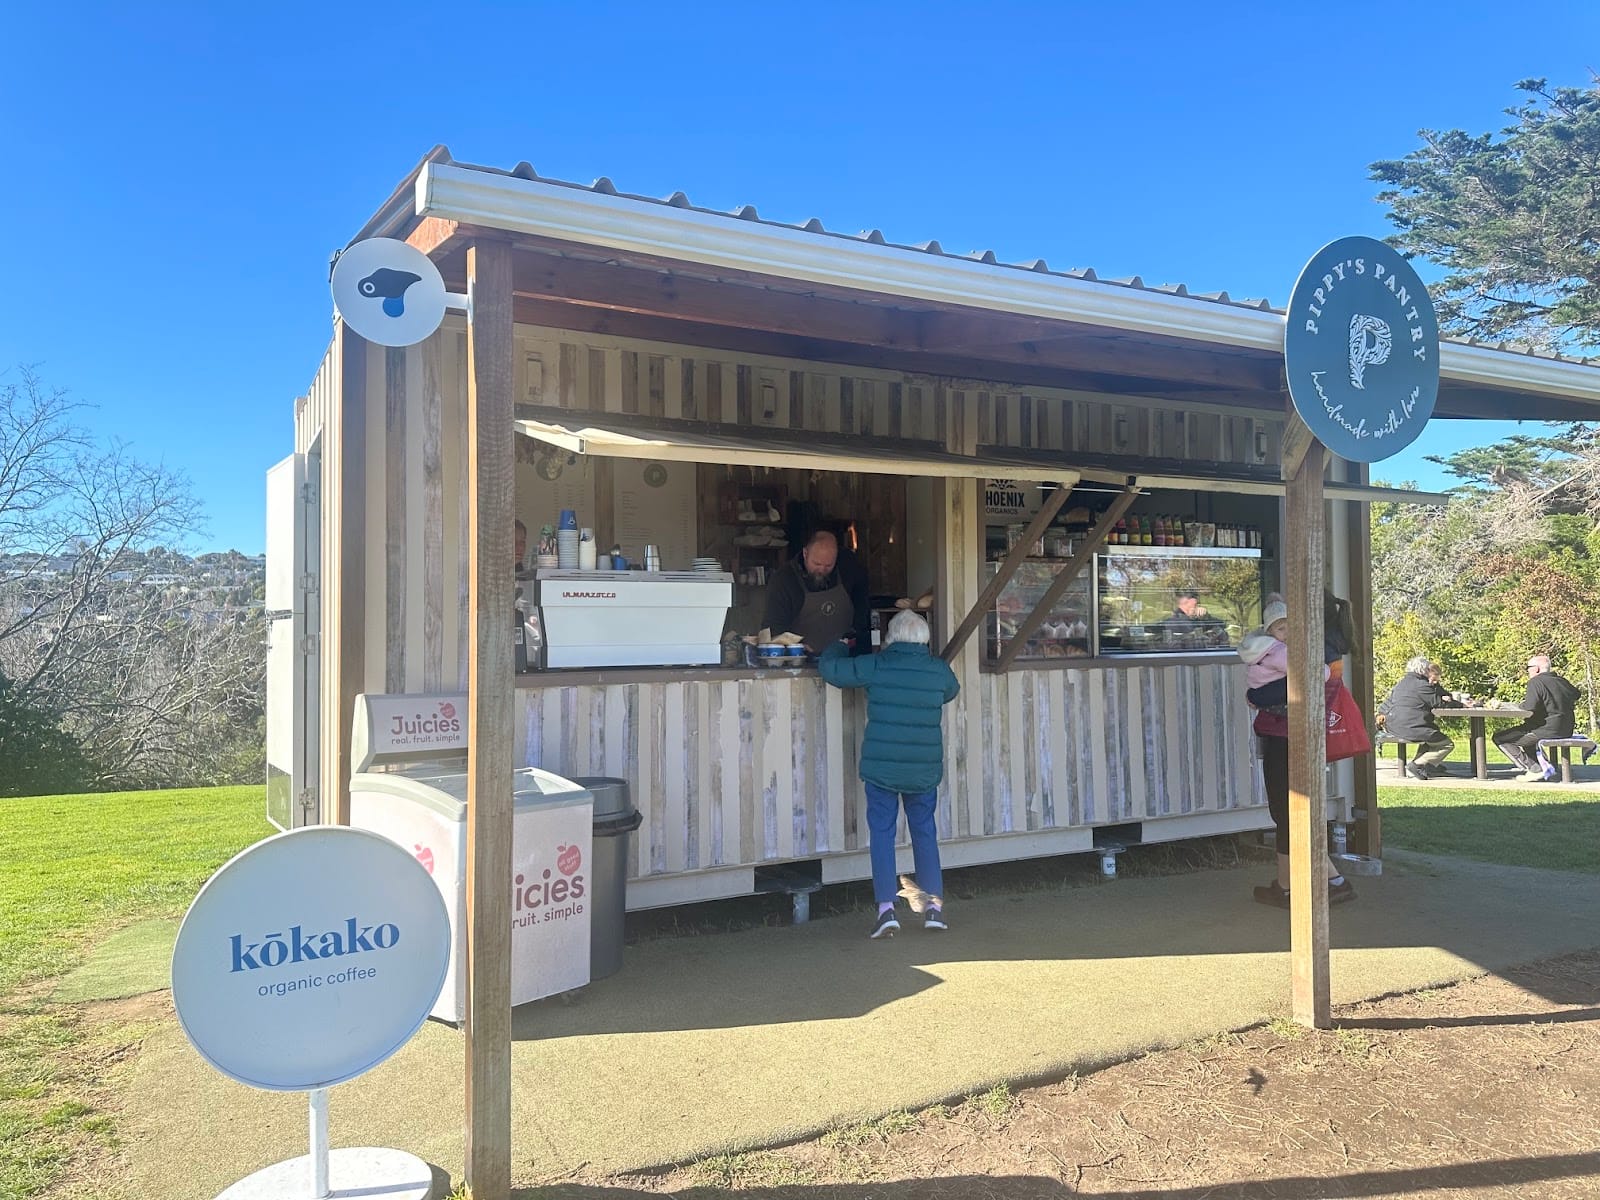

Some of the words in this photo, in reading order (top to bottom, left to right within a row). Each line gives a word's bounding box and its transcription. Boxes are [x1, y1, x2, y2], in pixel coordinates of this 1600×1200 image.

[1305, 258, 1365, 335] PIPPY'S
[1374, 263, 1426, 361] PANTRY
[1310, 371, 1370, 439] handmade
[1373, 409, 1403, 439] with
[1400, 385, 1419, 419] love
[985, 490, 1025, 508] HOENIX
[391, 713, 460, 736] Juicies
[391, 736, 411, 745] real.
[413, 735, 434, 744] fruit.
[436, 733, 460, 743] simple
[515, 868, 585, 912] icies
[512, 912, 540, 929] ruit.
[544, 902, 583, 921] simple
[228, 917, 400, 973] kōkako
[258, 975, 322, 996] organic
[327, 967, 377, 985] coffee
